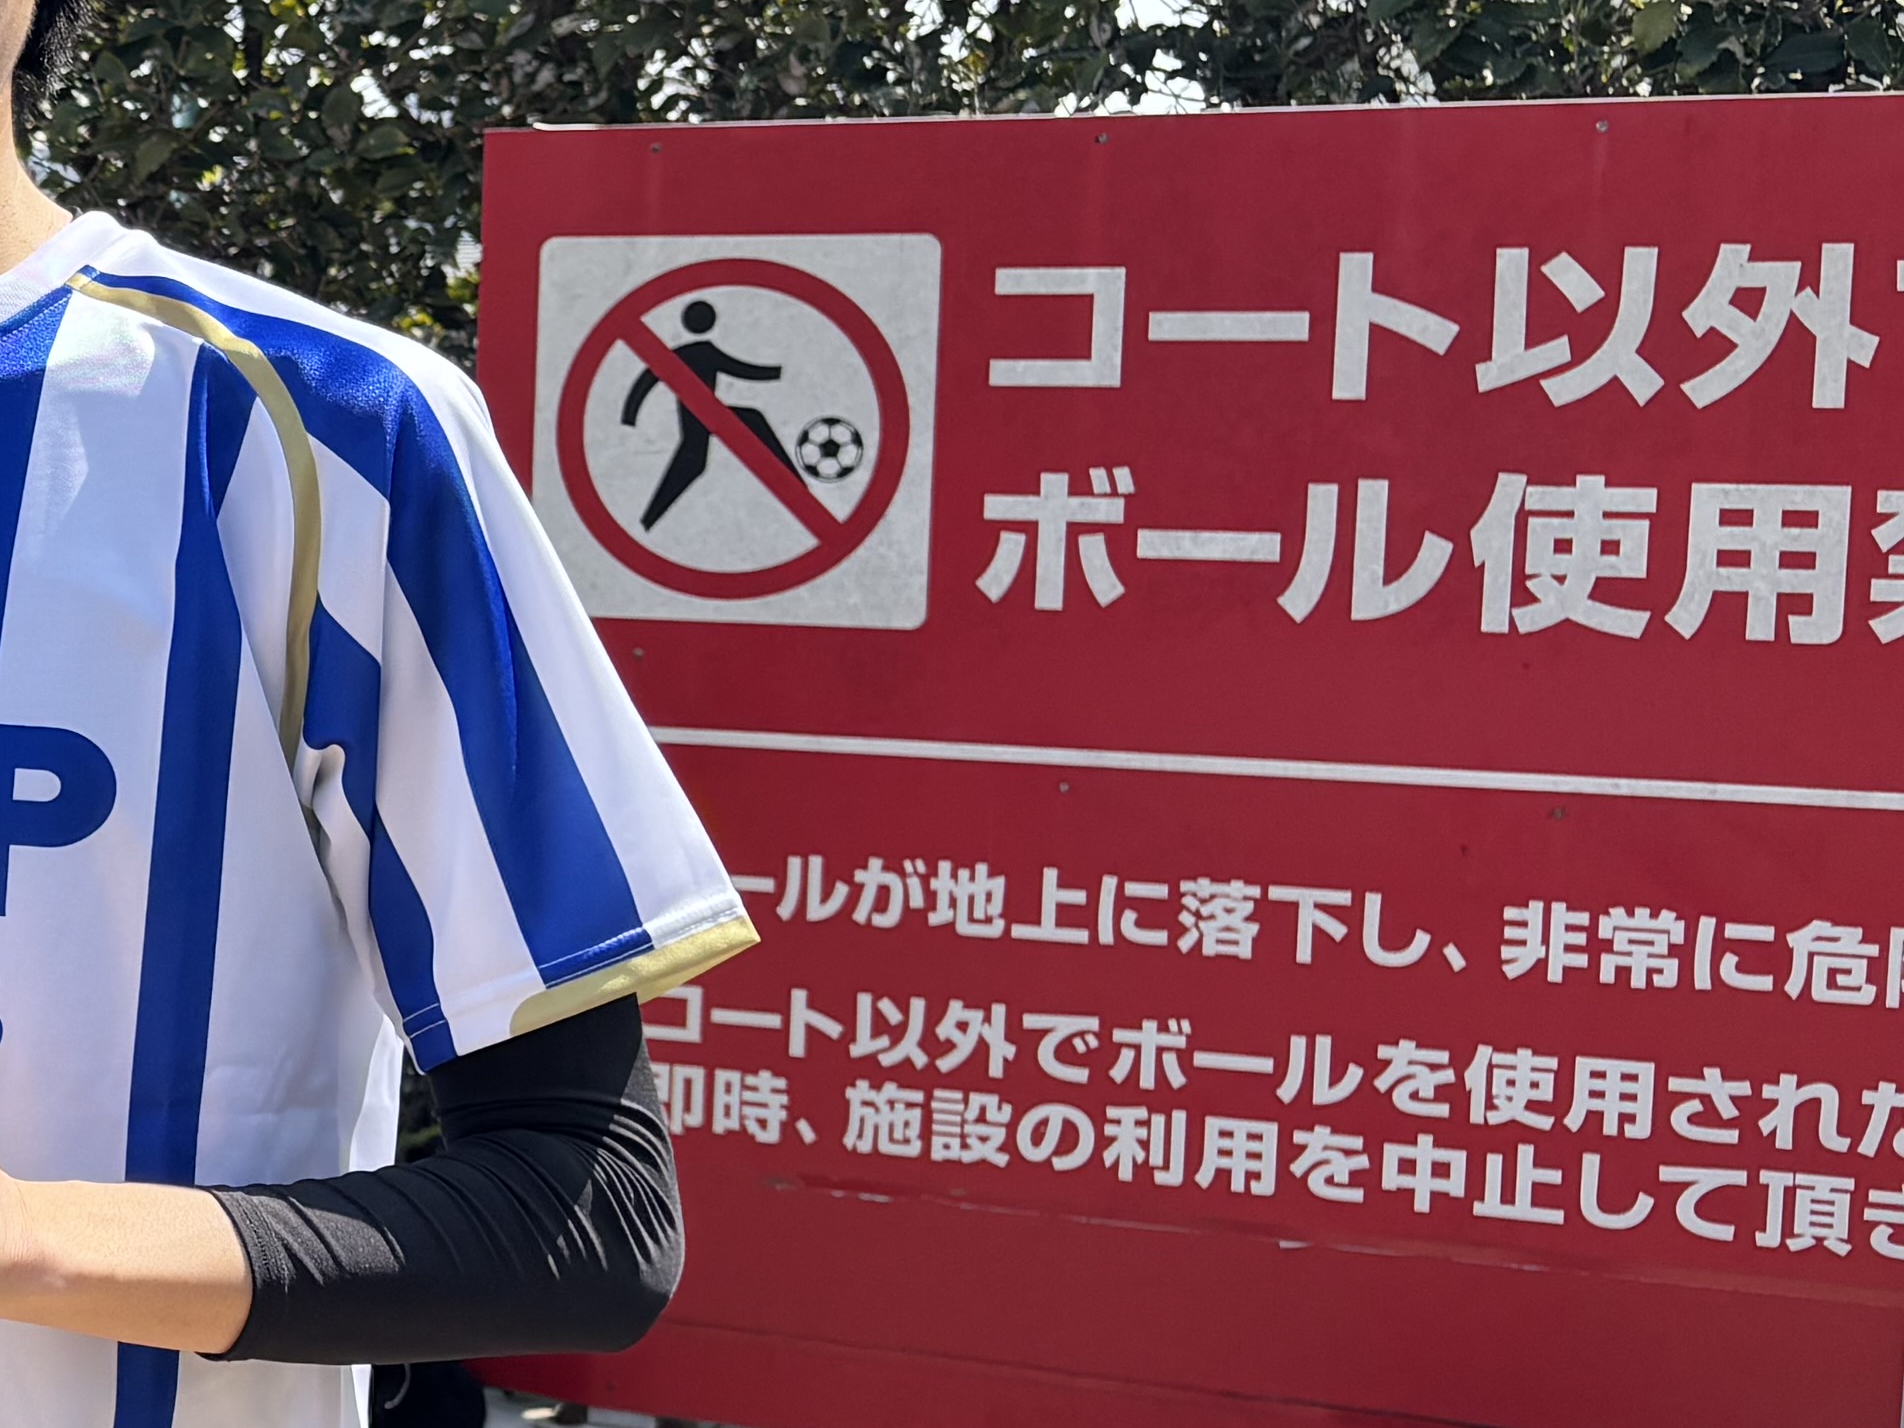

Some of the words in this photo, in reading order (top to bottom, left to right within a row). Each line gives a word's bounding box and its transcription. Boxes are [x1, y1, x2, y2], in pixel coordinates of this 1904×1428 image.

[988, 242, 1904, 410] コート以外
[732, 854, 1904, 1008] ールが地上に落下し、非常に危
